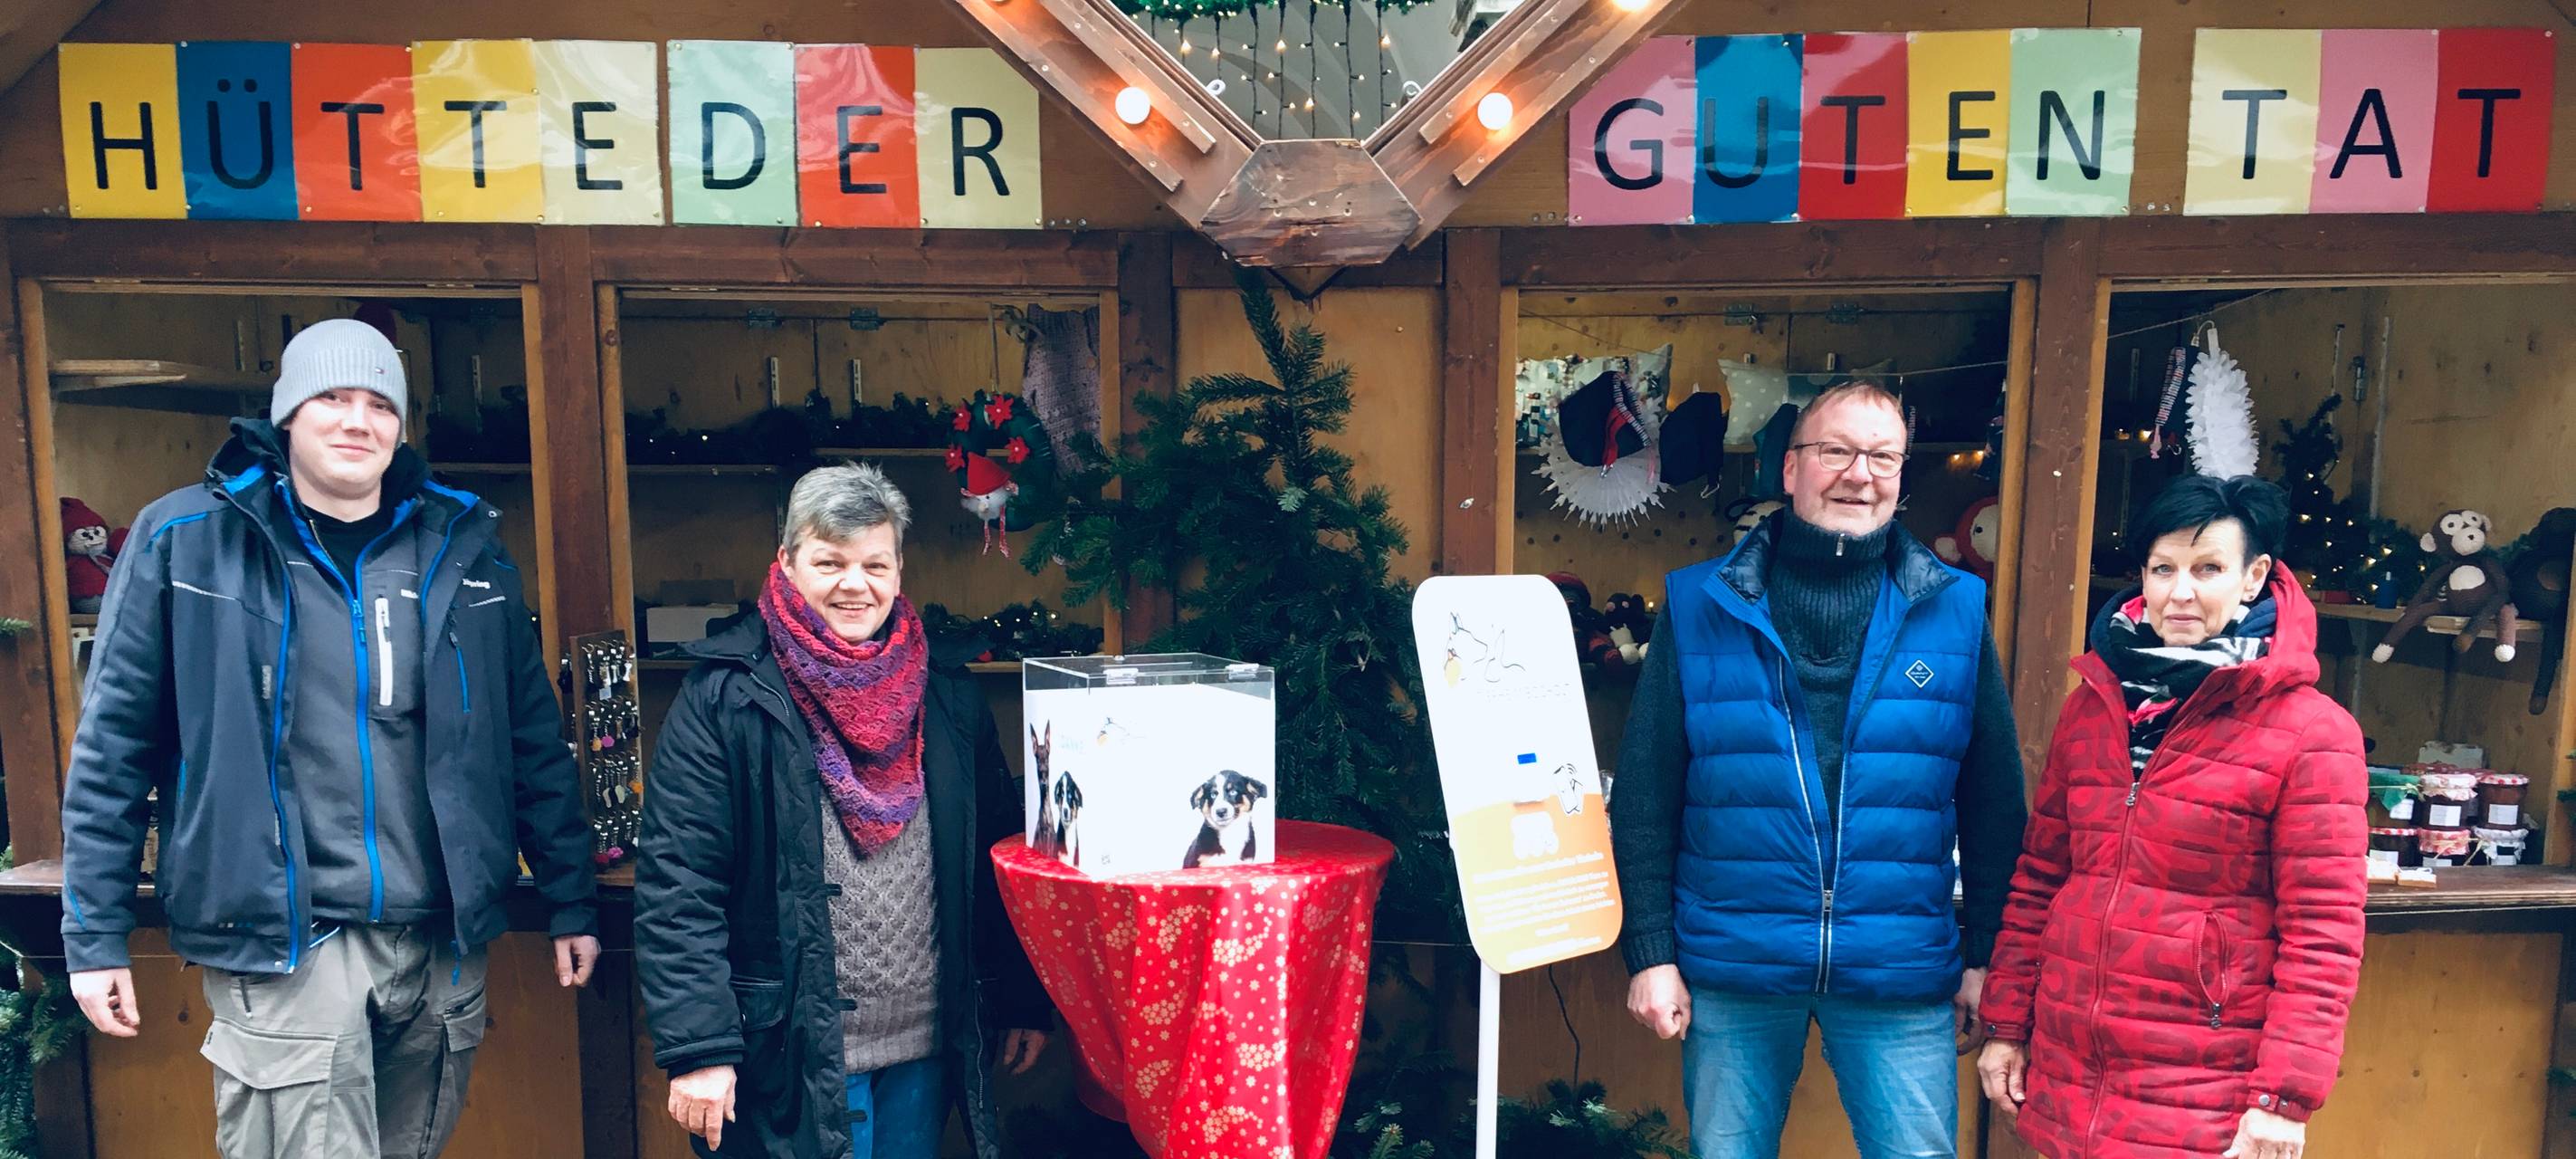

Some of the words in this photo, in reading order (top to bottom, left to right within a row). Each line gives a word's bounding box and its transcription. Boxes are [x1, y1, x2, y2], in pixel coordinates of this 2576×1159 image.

[91, 79, 623, 191] HÜTTE
[701, 101, 1010, 196] DER
[1593, 90, 2105, 190] GUTEN
[2221, 89, 2521, 179] TAT
